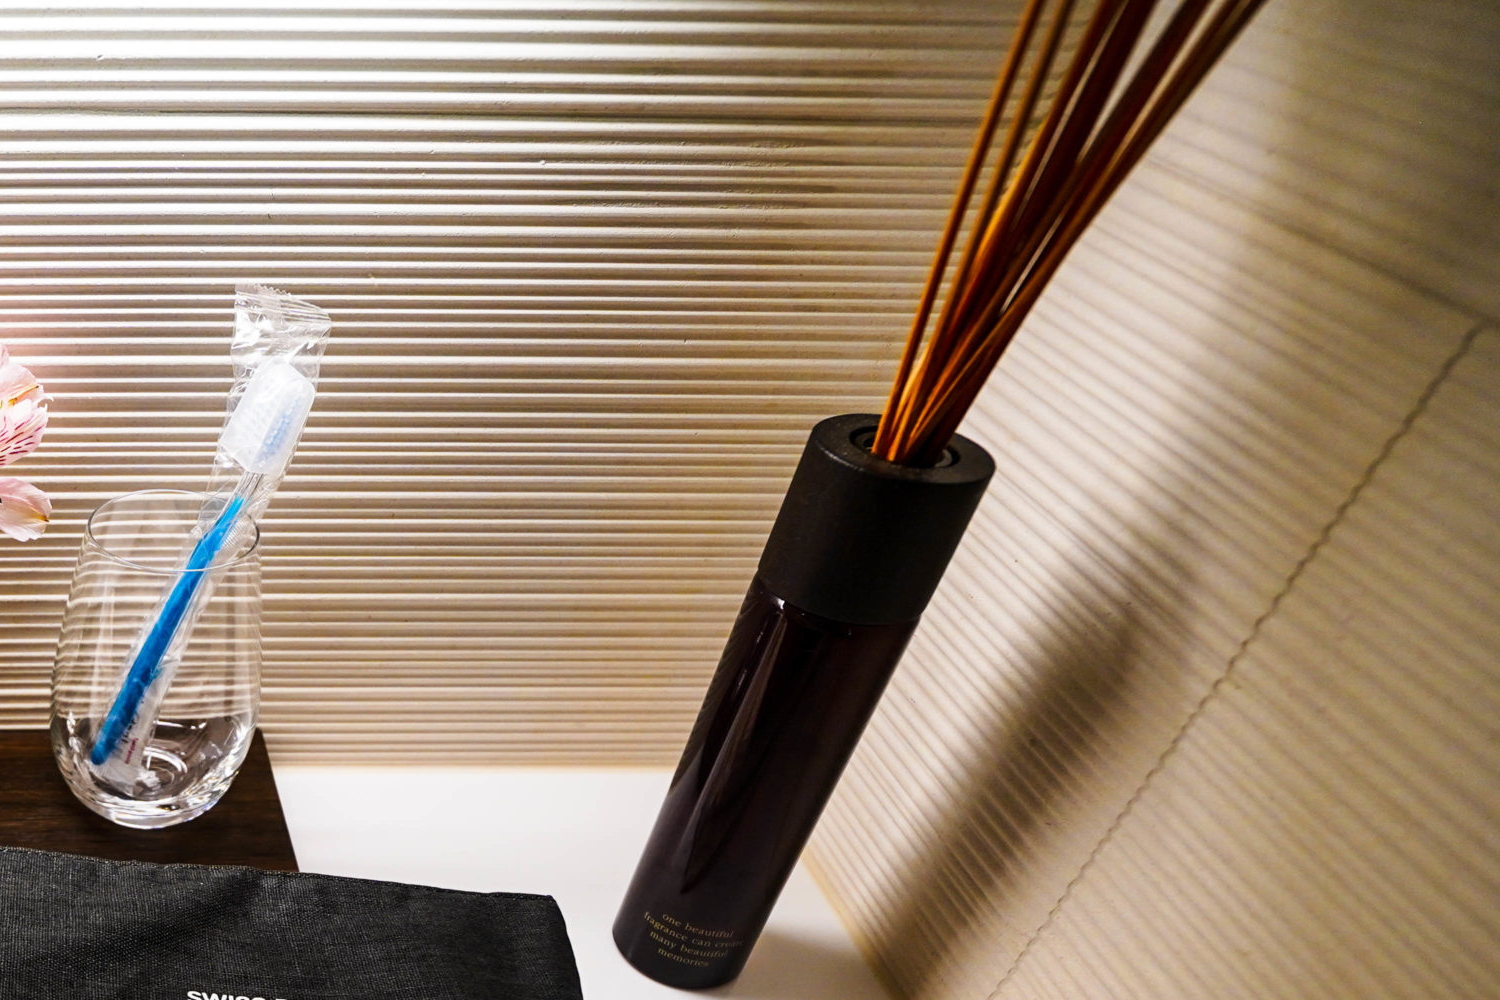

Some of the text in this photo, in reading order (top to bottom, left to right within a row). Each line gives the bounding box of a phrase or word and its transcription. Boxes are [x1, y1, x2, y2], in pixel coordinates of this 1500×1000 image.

[644, 911, 688, 941] fragrance
[691, 937, 712, 947] can
[662, 913, 735, 938] one beautiful
[650, 930, 729, 958] many beautiful
[657, 947, 709, 967] memories
